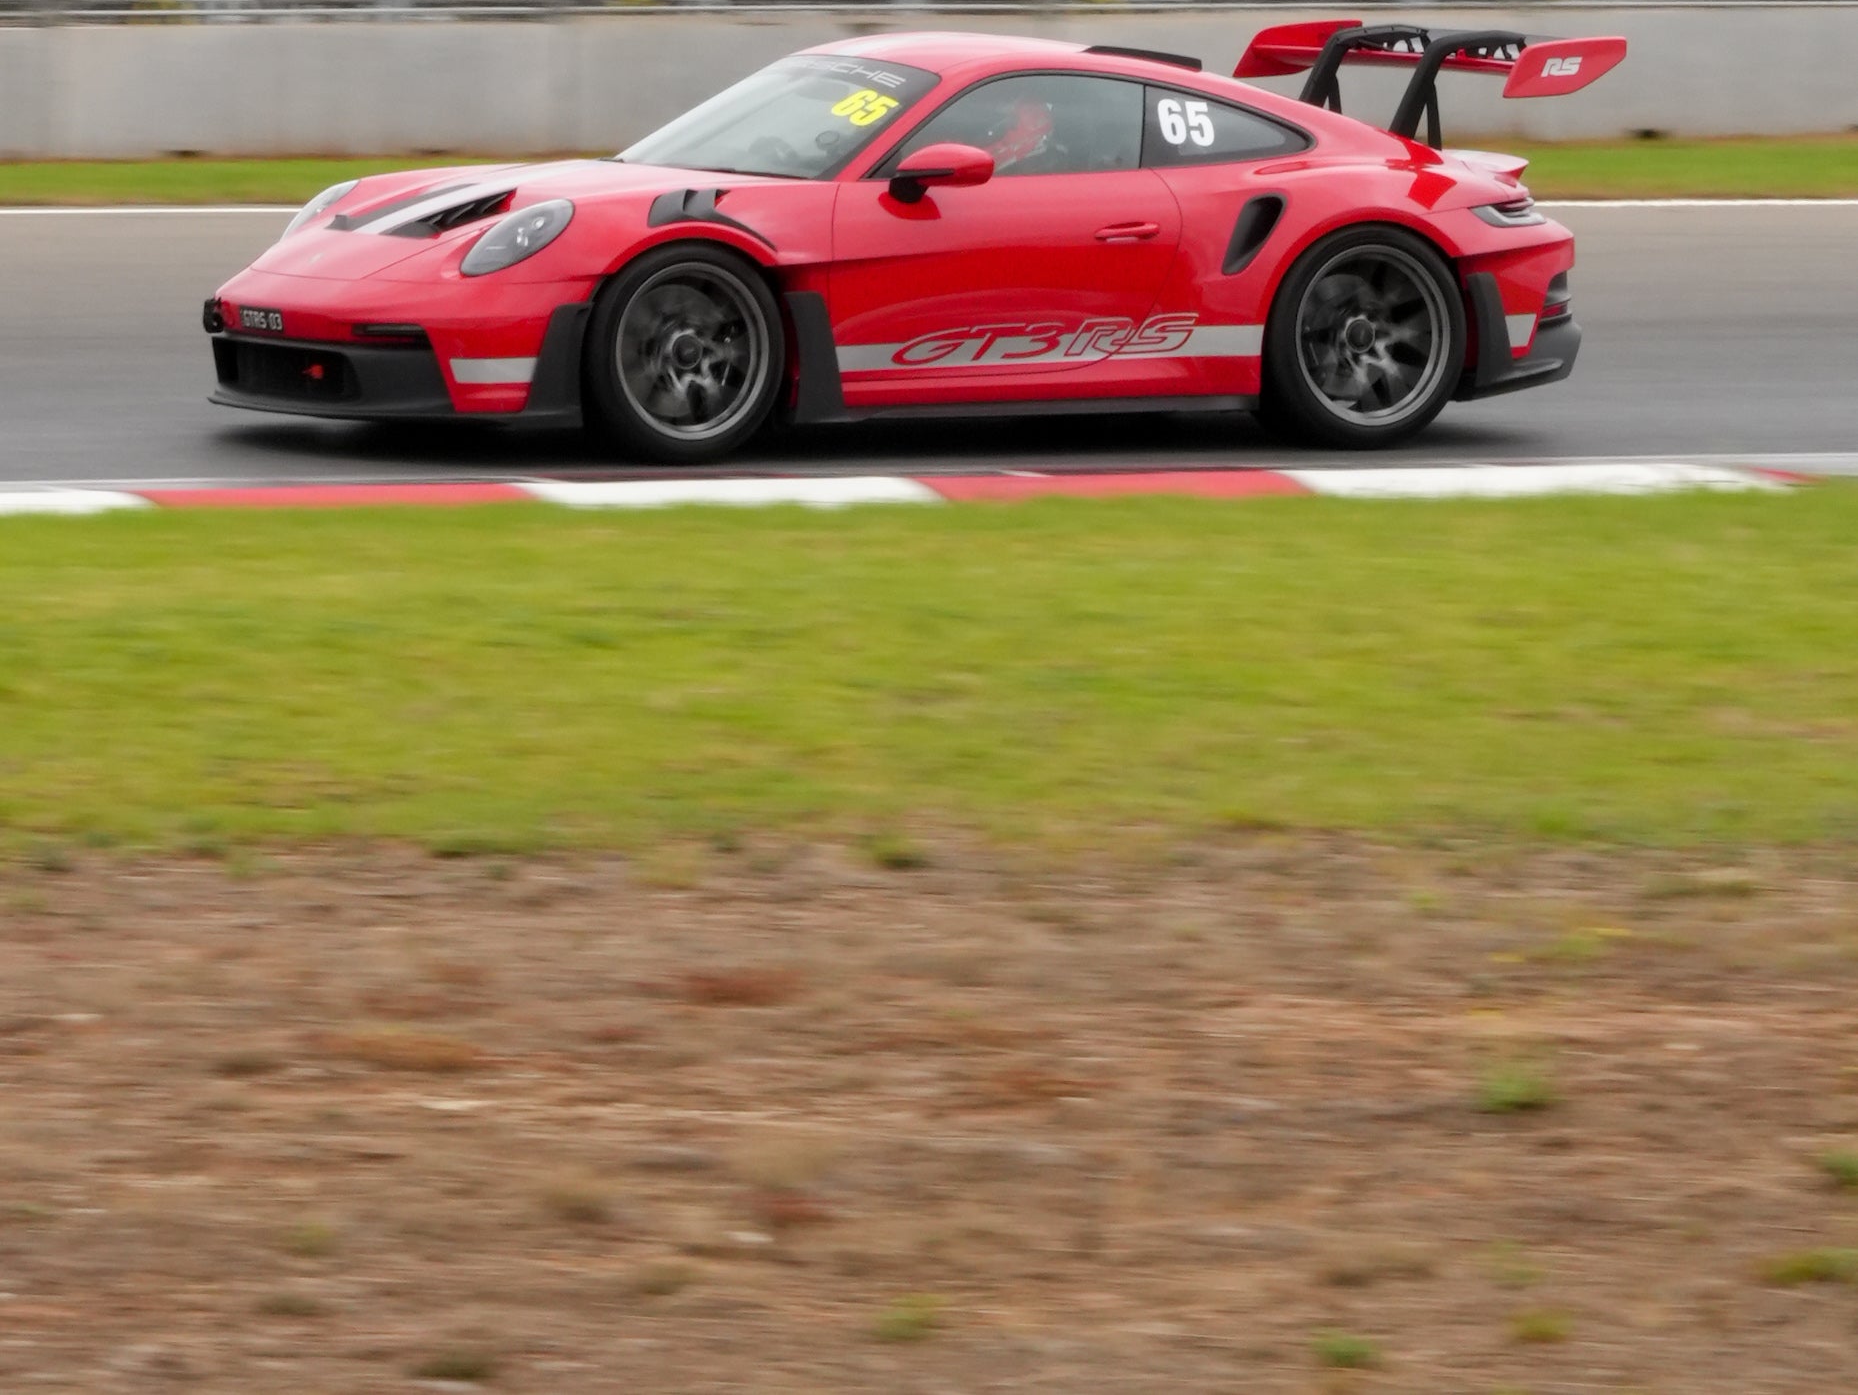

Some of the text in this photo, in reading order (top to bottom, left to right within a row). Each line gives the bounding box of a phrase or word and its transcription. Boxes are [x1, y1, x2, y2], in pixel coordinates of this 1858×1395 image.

[787, 61, 906, 88] SCHE
[1540, 56, 1583, 78] RS
[831, 89, 899, 126] 65
[1157, 98, 1215, 147] 65
